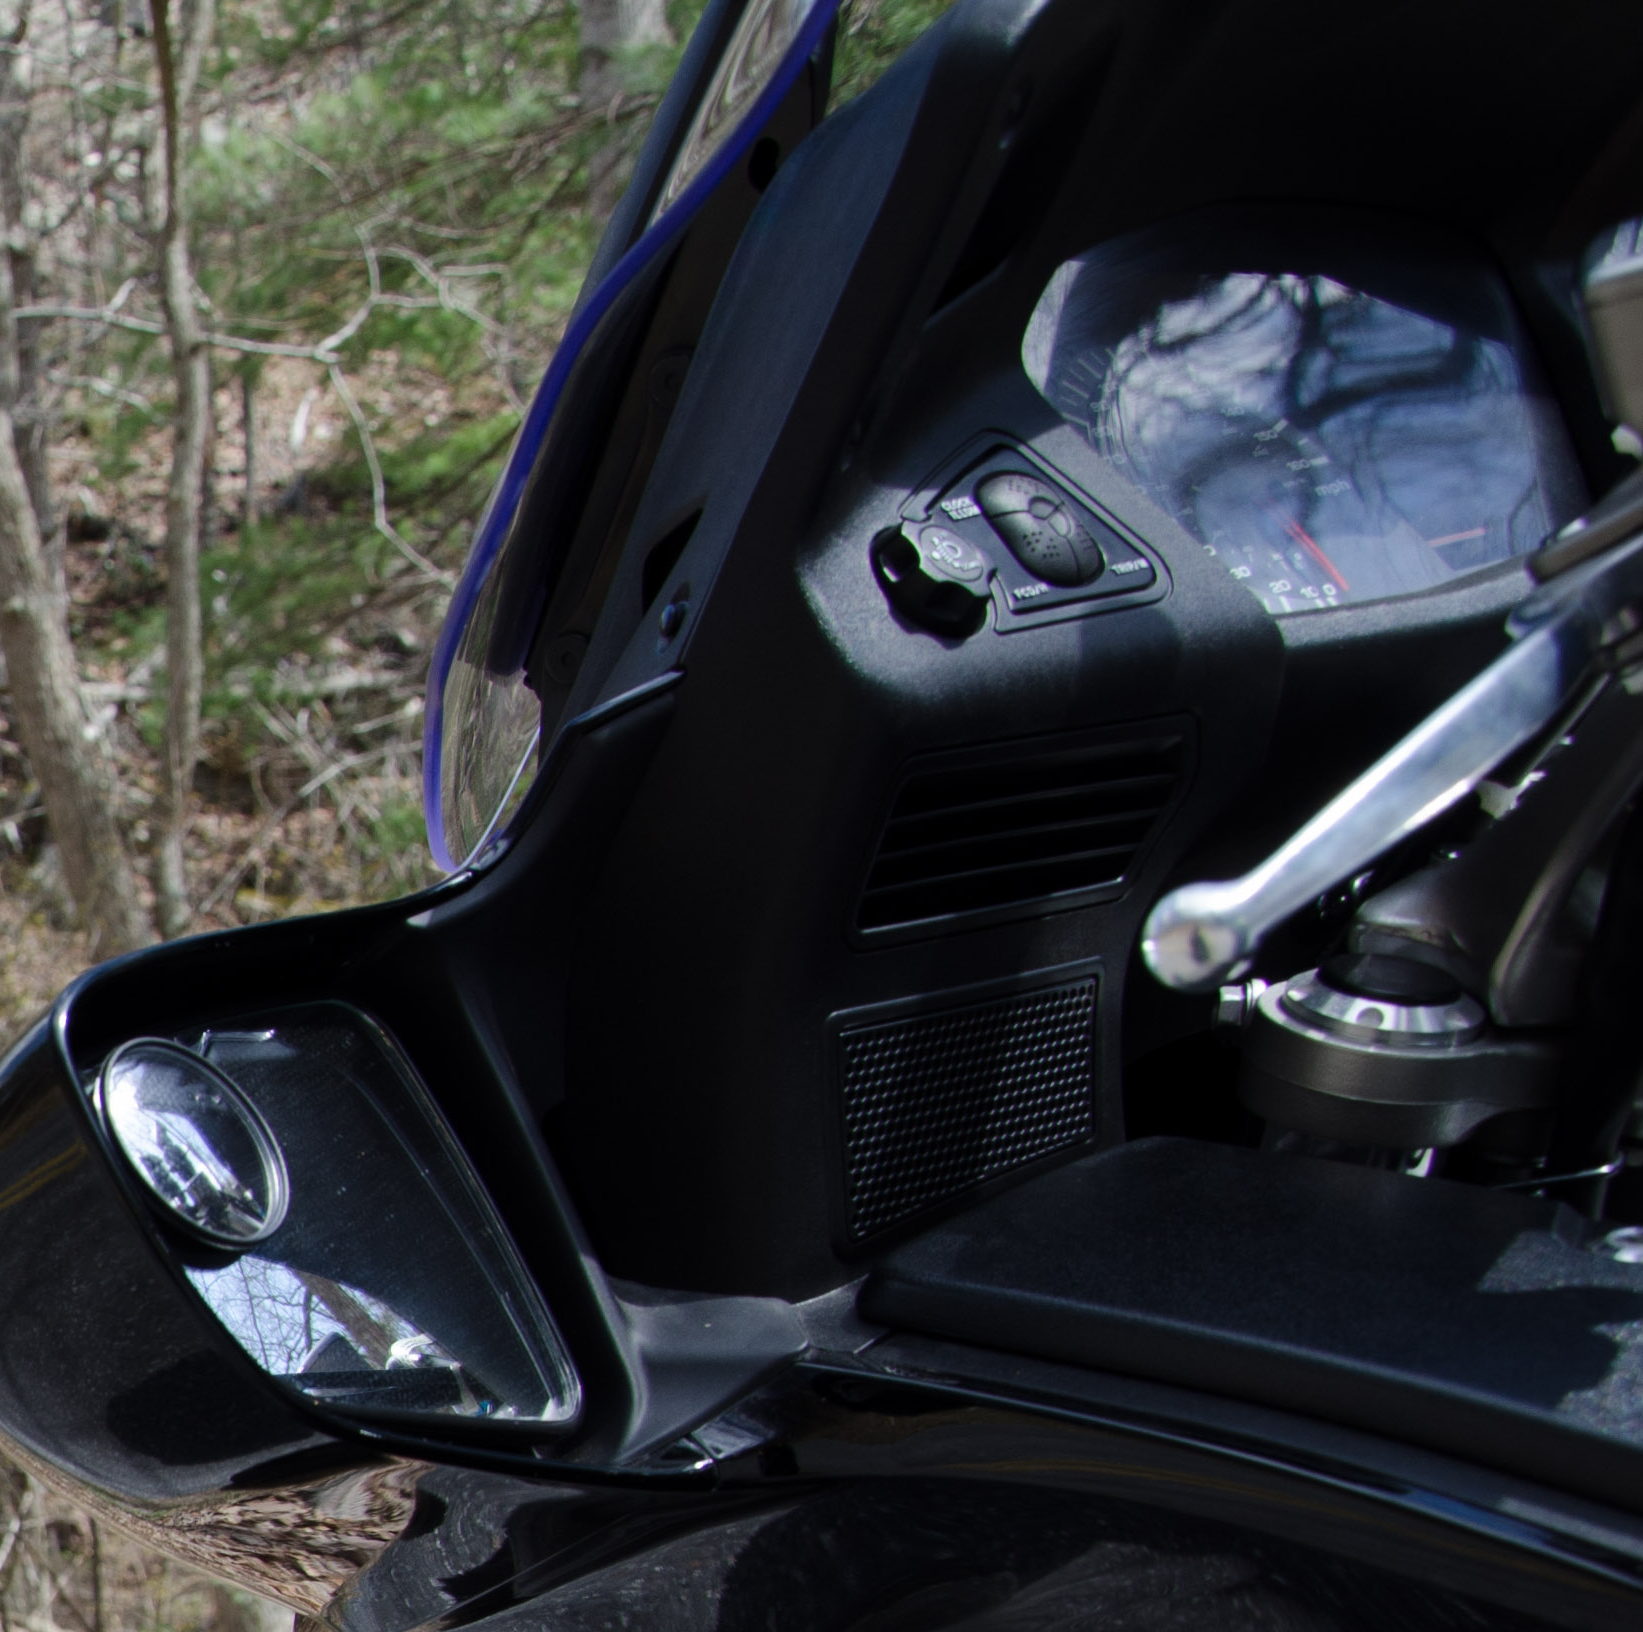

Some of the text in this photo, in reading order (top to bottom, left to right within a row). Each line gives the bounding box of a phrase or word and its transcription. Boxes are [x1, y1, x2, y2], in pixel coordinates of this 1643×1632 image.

[1315, 478, 1351, 497] mph
[1268, 579, 1292, 594] 20
[1300, 585, 1320, 599] 10
[1322, 583, 1337, 597] 0
